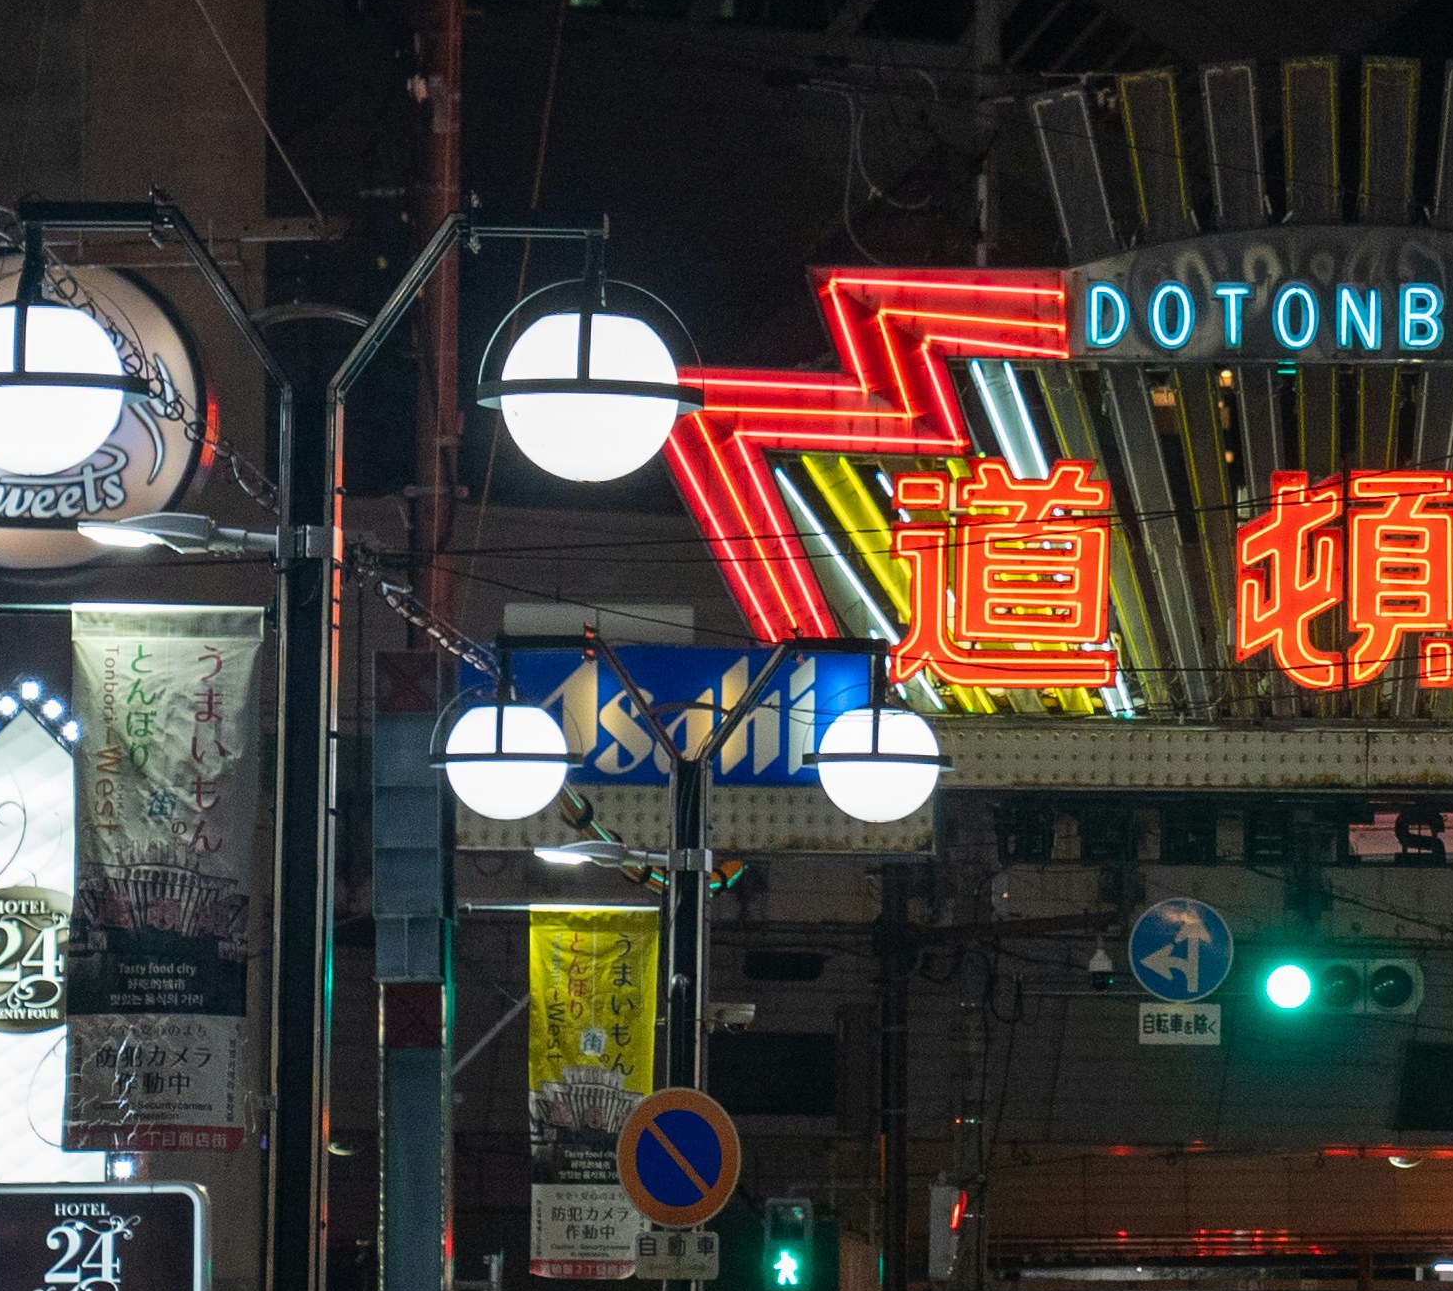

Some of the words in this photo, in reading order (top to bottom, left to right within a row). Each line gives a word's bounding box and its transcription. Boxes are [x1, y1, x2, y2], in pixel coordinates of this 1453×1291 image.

[126, 644, 157, 770] とんぼり
[545, 654, 817, 776] Asahi
[190, 646, 233, 853] うまいもん
[119, 963, 146, 977] Tasty
[147, 963, 173, 975] food
[175, 963, 197, 977] city
[610, 932, 634, 1076] うまいもん
[1140, 1014, 1218, 1036] 自転車を除く
[54, 1203, 111, 1217] HOTEL
[550, 1208, 629, 1222] 防犯カメラ
[45, 1224, 122, 1285] 24
[638, 1235, 716, 1257] 自動車
